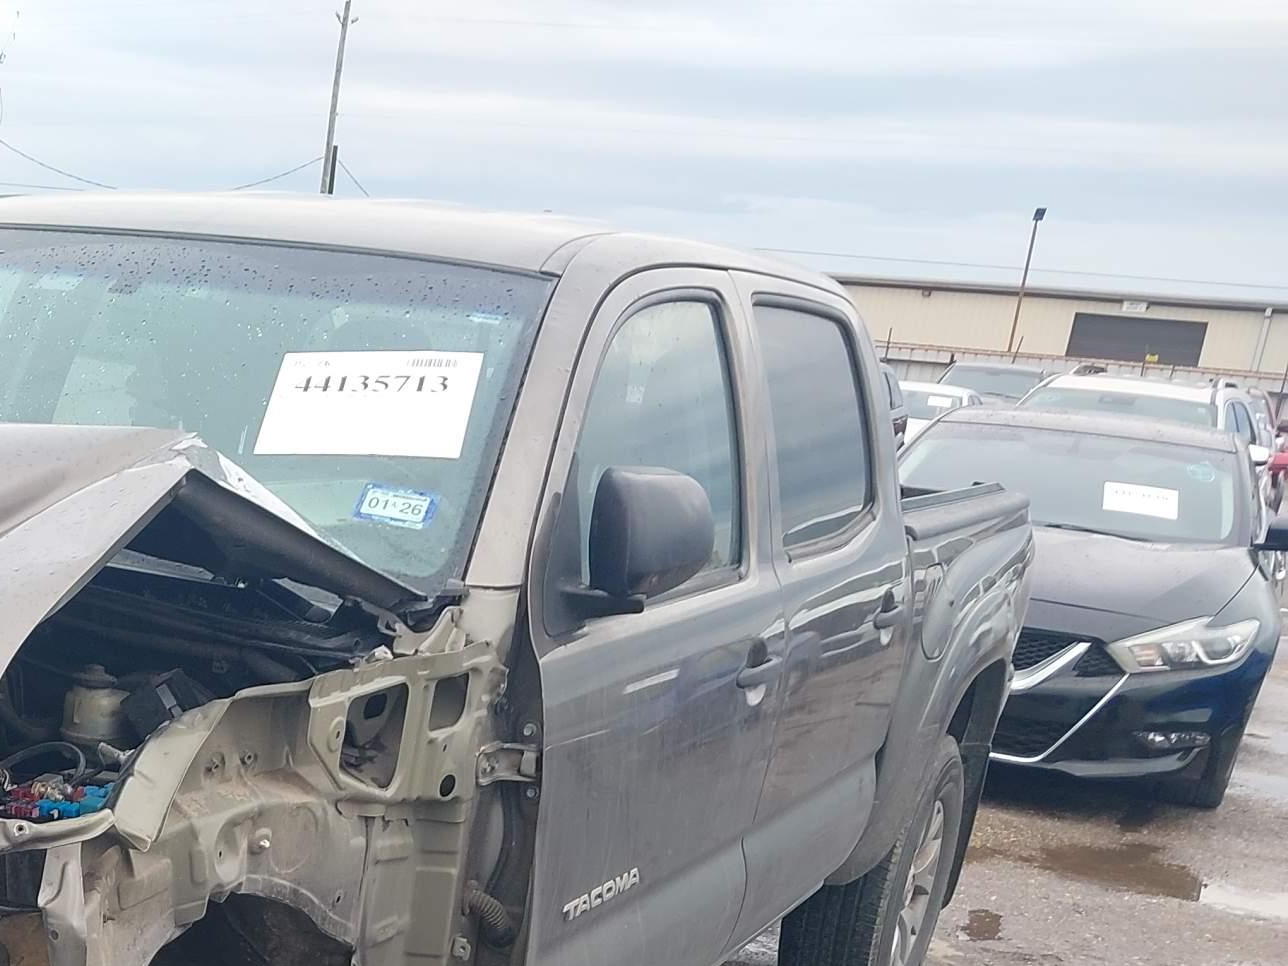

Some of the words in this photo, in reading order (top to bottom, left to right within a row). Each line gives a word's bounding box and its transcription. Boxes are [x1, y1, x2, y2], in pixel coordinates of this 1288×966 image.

[294, 375, 449, 392] 44135713
[398, 502, 424, 517] 26
[562, 866, 641, 922] TACOMA
